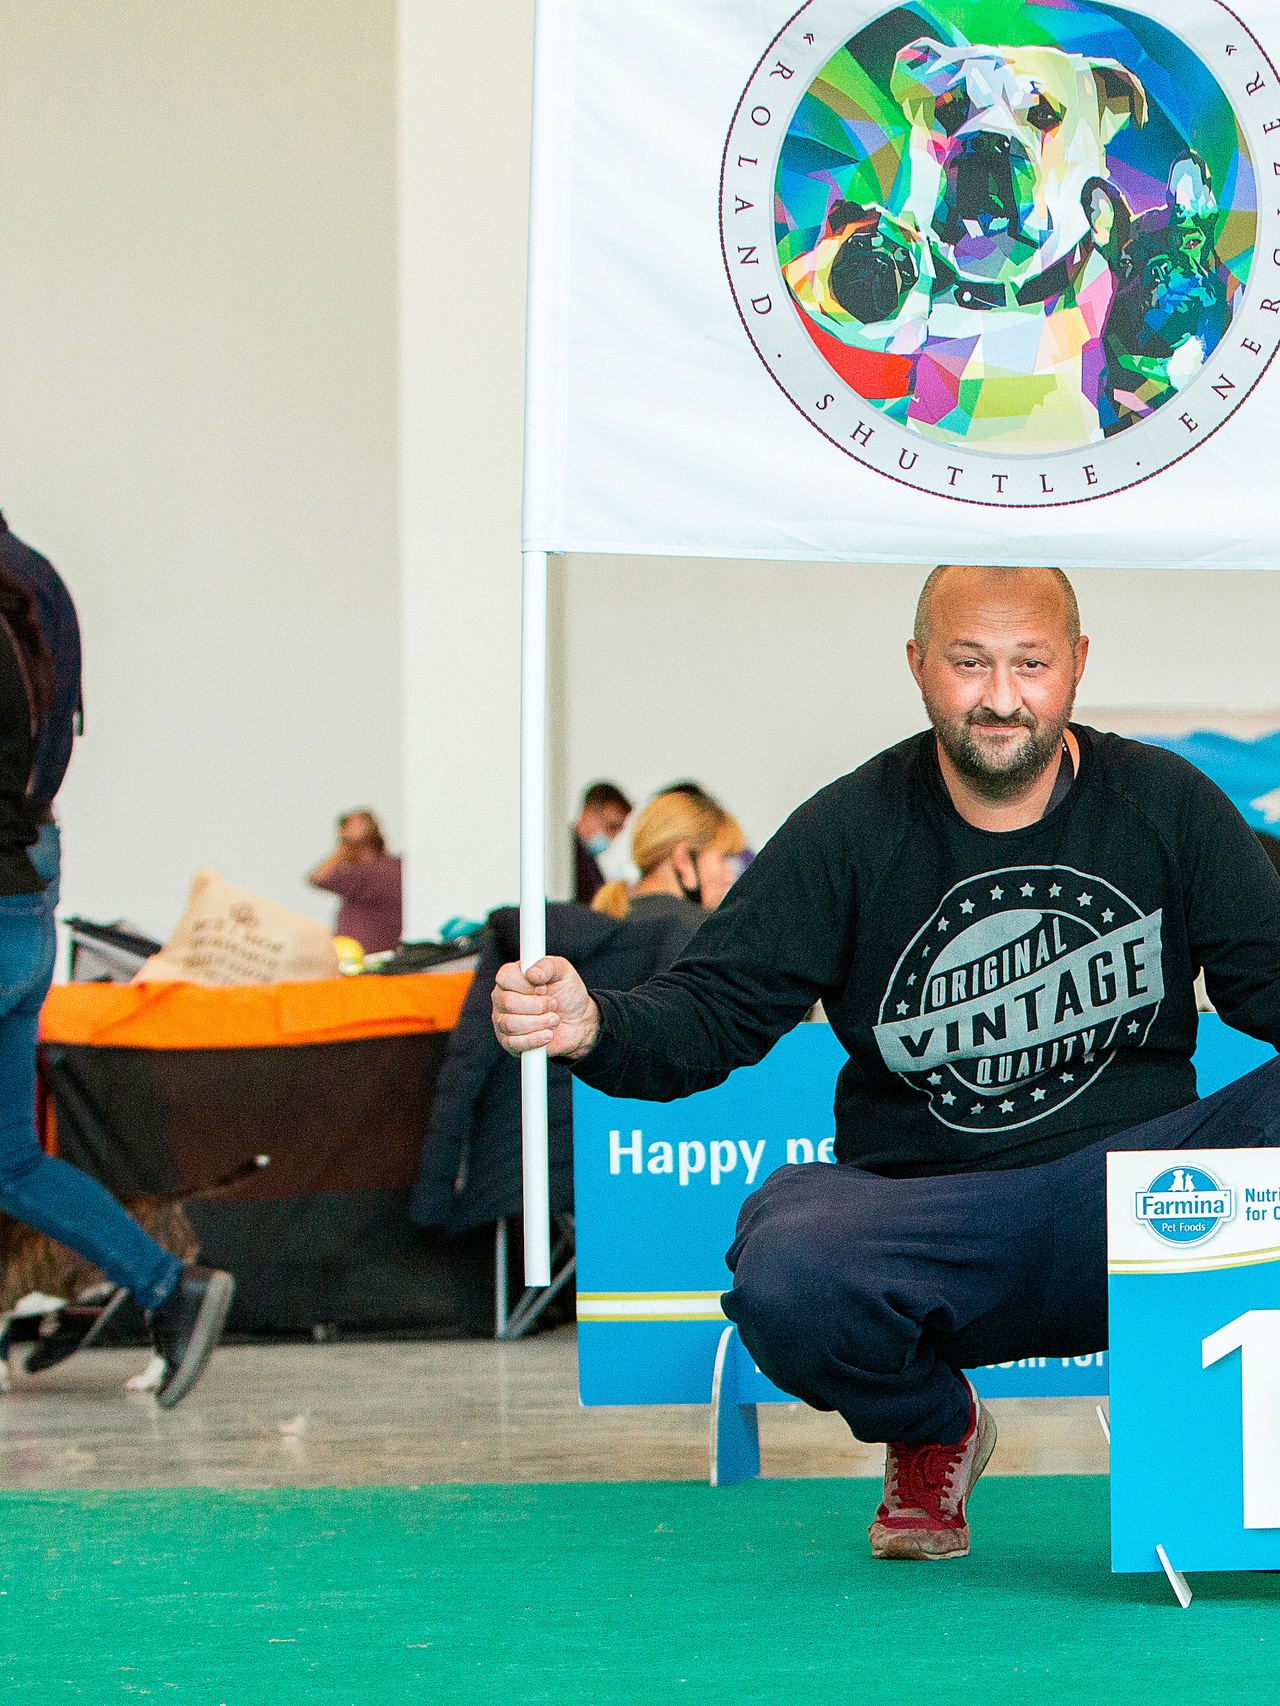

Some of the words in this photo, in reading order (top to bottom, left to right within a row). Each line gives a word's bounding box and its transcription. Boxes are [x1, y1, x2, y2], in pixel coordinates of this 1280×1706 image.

[931, 916, 1068, 1008] ORIGINAL
[898, 936, 1149, 1059] VINTAGE
[976, 1028, 1096, 1085] QUALITY
[608, 1129, 766, 1186] Happy
[1142, 1194, 1225, 1216] Farmina
[1161, 1222, 1177, 1232] Pet
[1179, 1221, 1206, 1232] Foods
[1245, 1206, 1268, 1221] for
